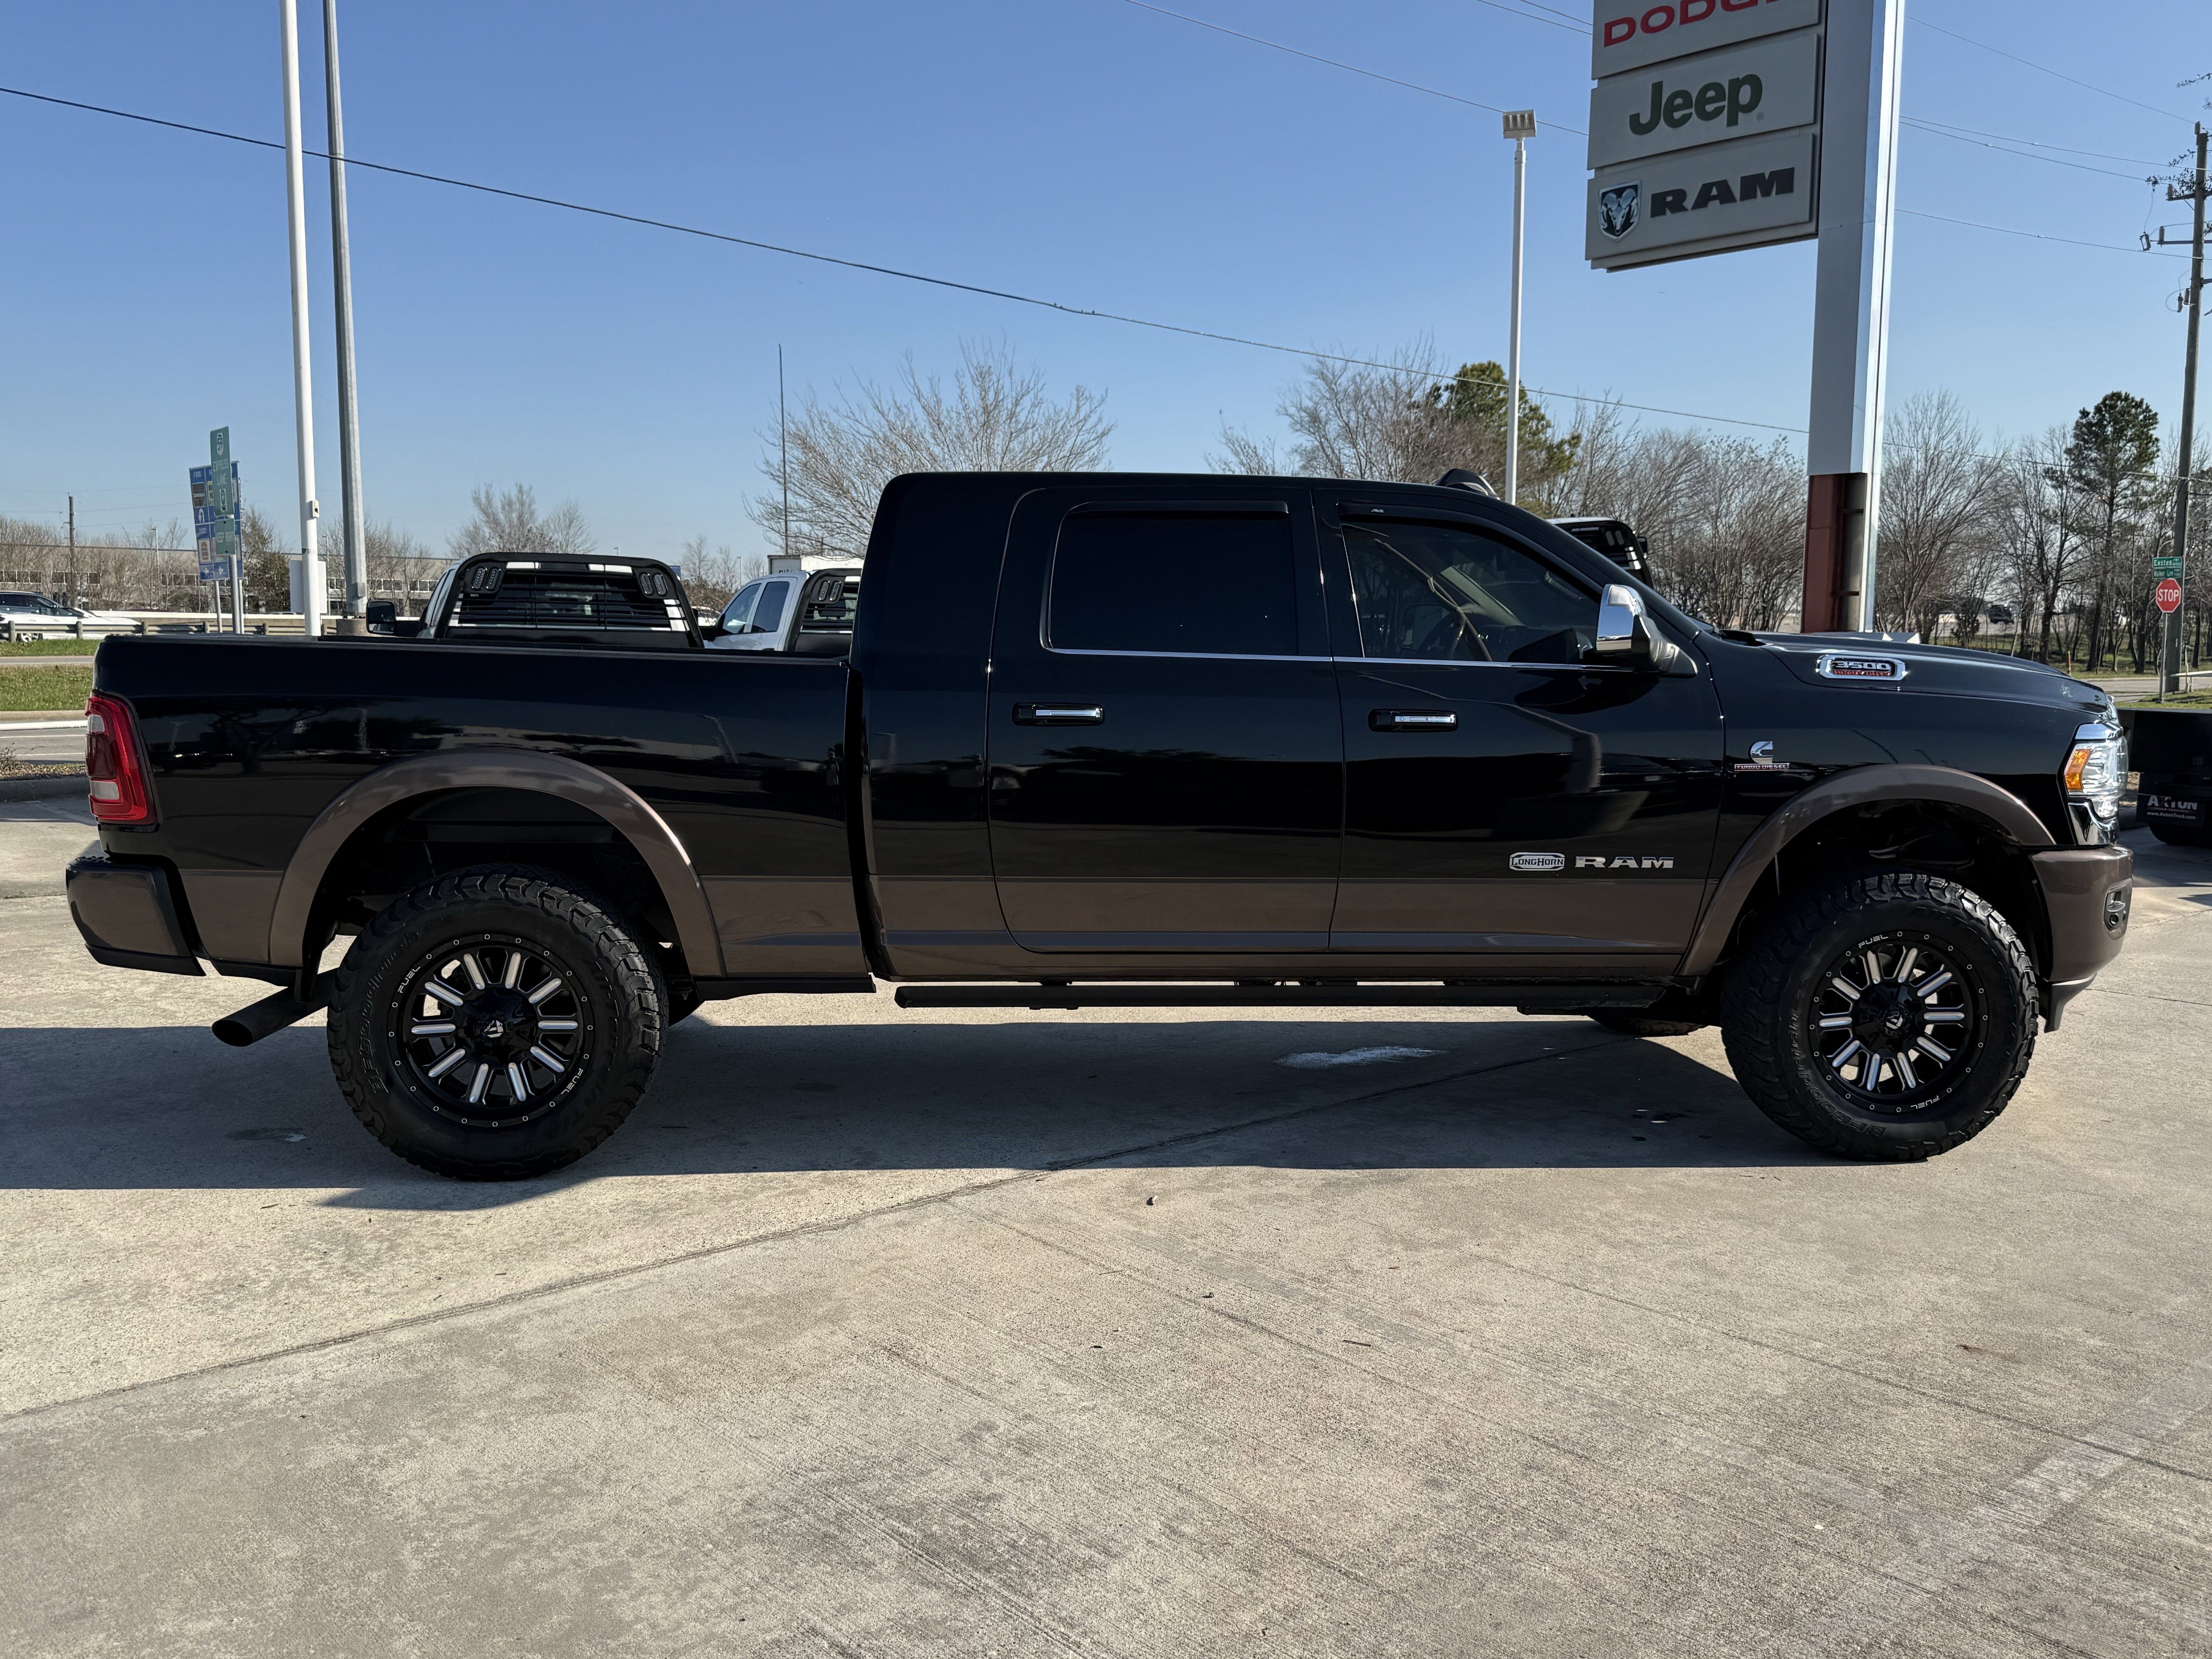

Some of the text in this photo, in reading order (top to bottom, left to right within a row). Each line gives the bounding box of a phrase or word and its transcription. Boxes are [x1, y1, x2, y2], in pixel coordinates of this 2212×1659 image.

[1604, 0, 1782, 48] DOD
[1629, 73, 1763, 135] Jeep
[1650, 167, 1795, 218] RAM
[2158, 589, 2179, 601] STOP
[1833, 661, 1891, 670] 3500
[1575, 856, 1674, 868] RAM
[1858, 934, 1889, 949] FUEL
[397, 966, 421, 993] FUEL
[560, 1068, 584, 1094] FUEL
[1910, 1095, 1940, 1109] FUEL
